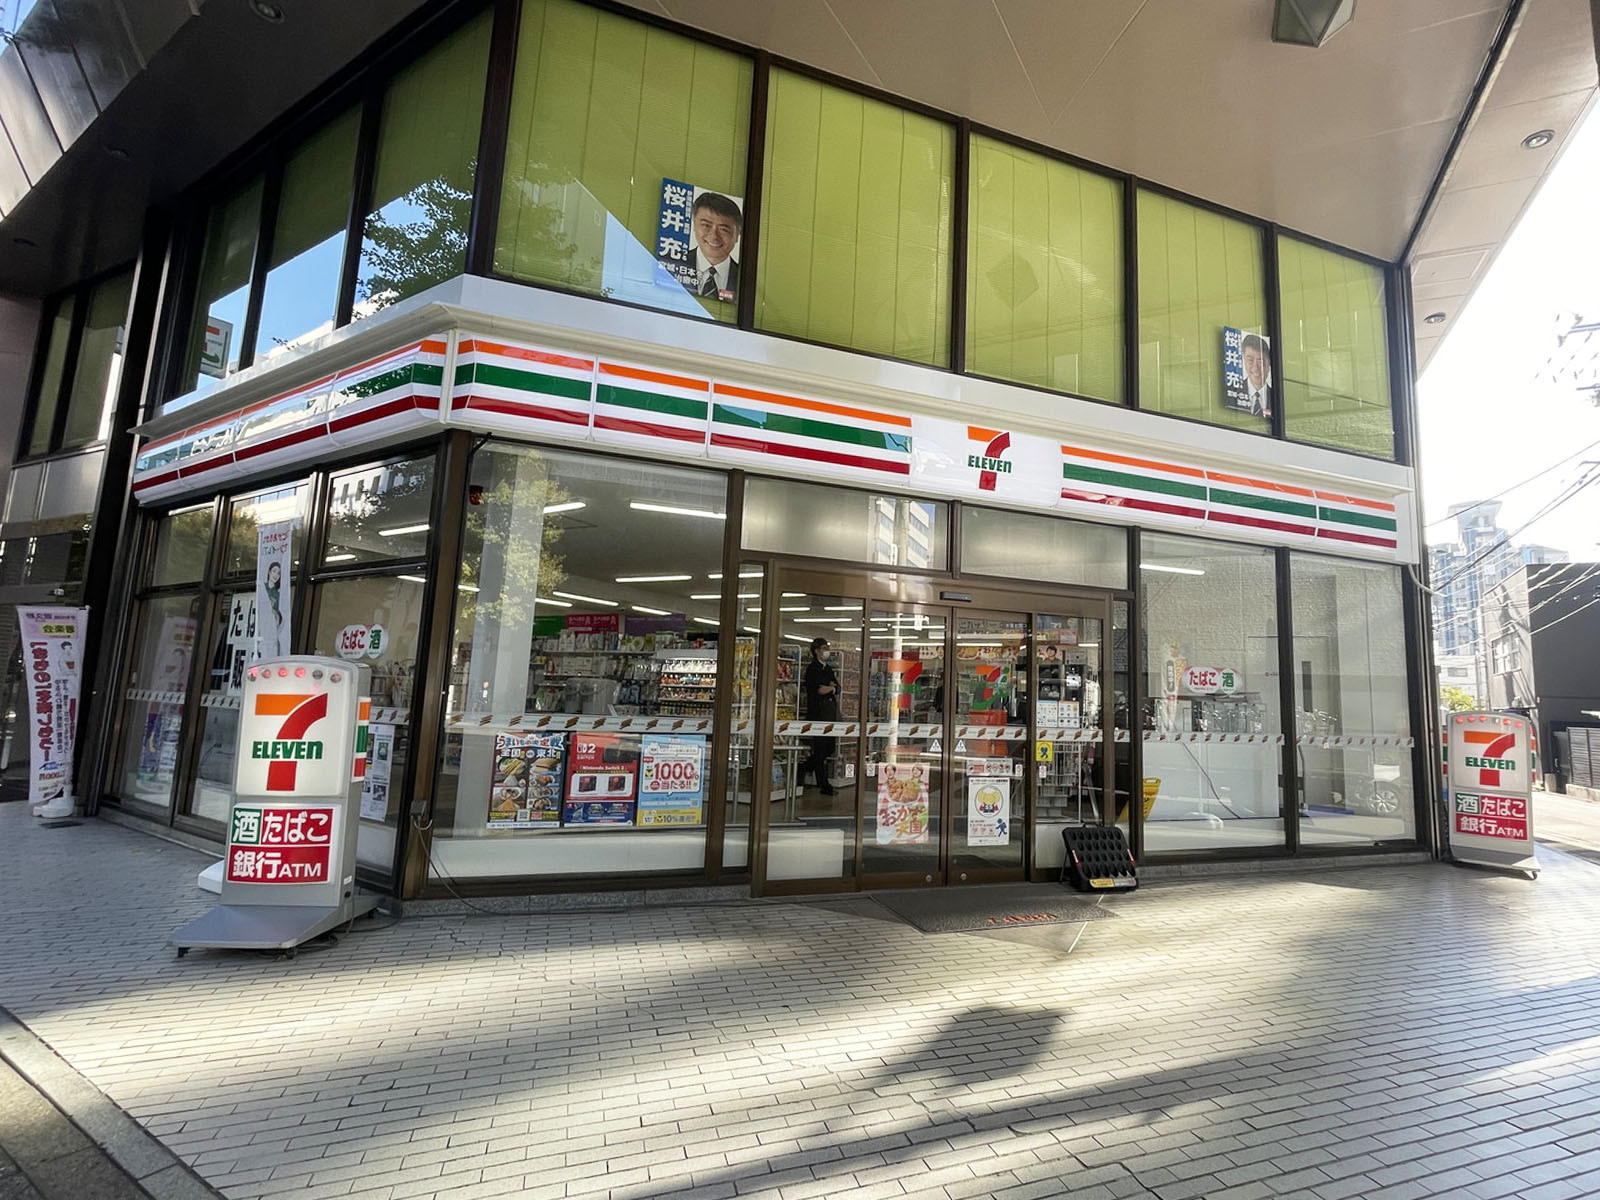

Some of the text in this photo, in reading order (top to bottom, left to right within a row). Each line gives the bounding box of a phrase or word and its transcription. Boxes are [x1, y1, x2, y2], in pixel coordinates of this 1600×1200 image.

[659, 184, 687, 260] 桜井充
[1225, 330, 1240, 389] 桜井充
[968, 425, 1010, 491] 7
[340, 629, 382, 650] たばこ 酒
[1189, 670, 1217, 687] たばこ
[1222, 672, 1234, 687] 酒
[255, 692, 328, 791] 7
[1464, 731, 1516, 787] 7
[232, 810, 329, 844] 酒 たばこ
[1457, 794, 1525, 818] 酒 たばこ
